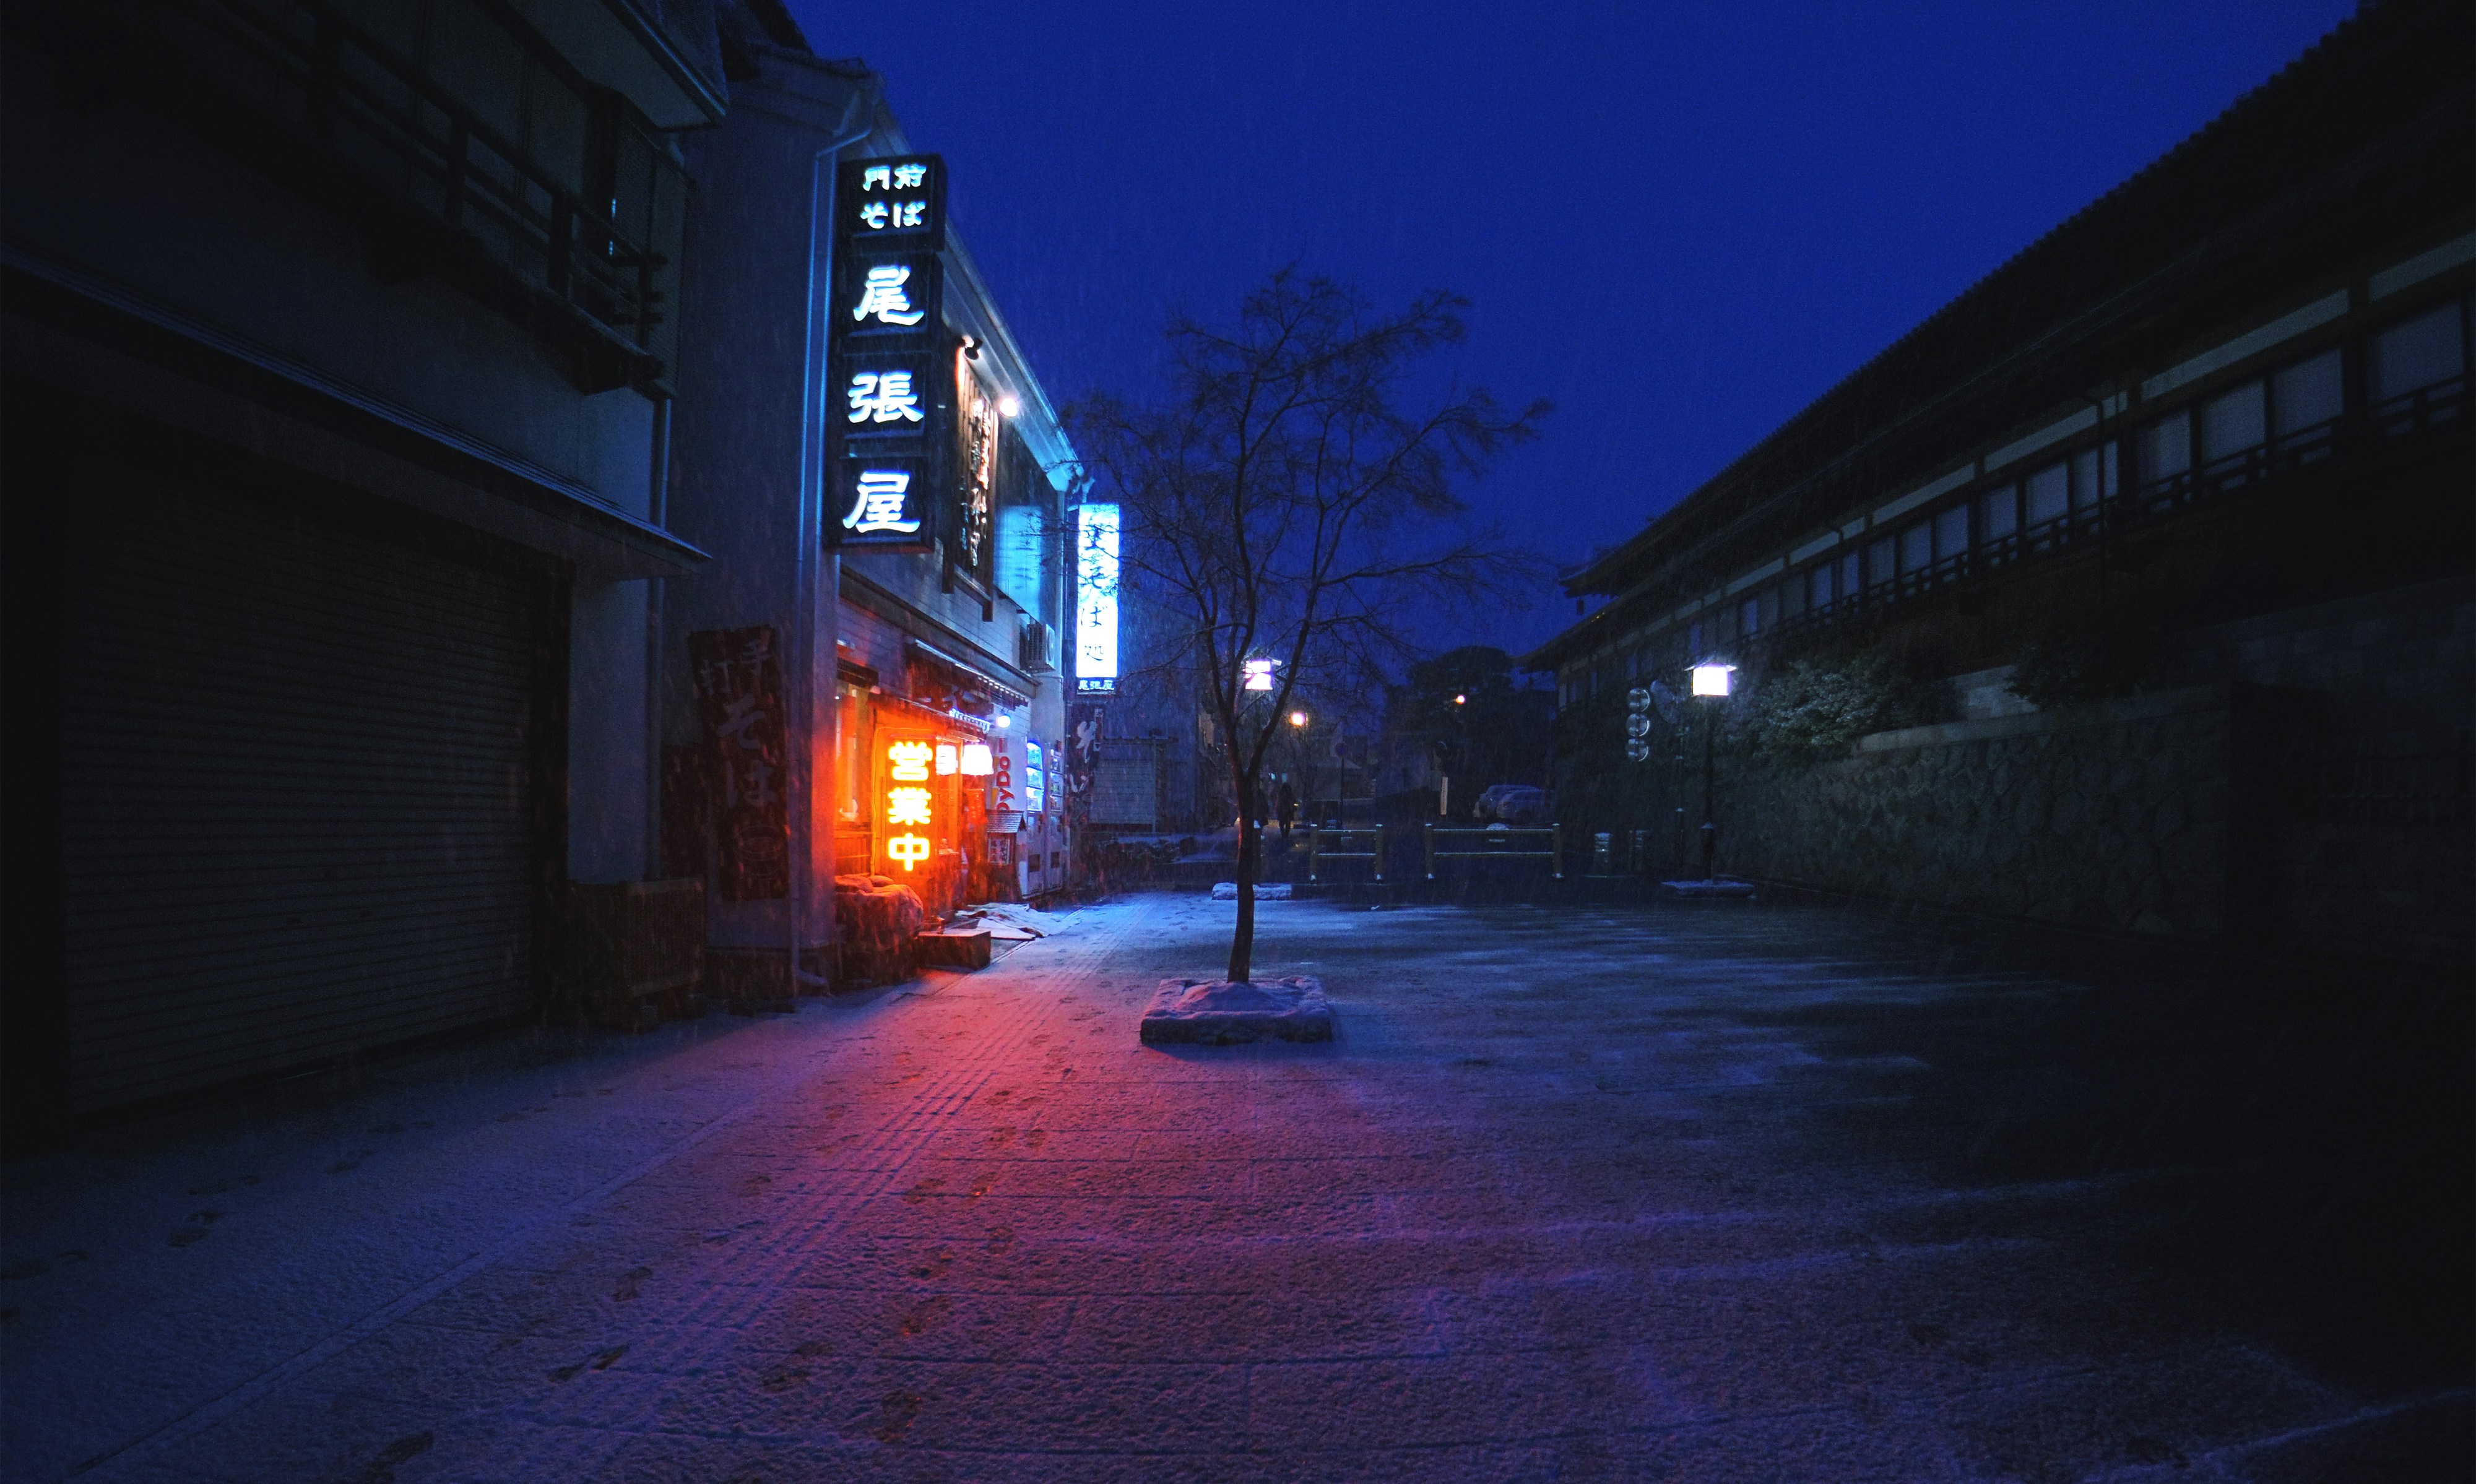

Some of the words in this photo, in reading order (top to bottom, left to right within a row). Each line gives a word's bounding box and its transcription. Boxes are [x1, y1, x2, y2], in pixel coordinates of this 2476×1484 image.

[860, 201, 925, 228] そば
[863, 164, 927, 191] 門前
[842, 264, 925, 533] 尾張屋
[887, 740, 933, 873] 営業中
